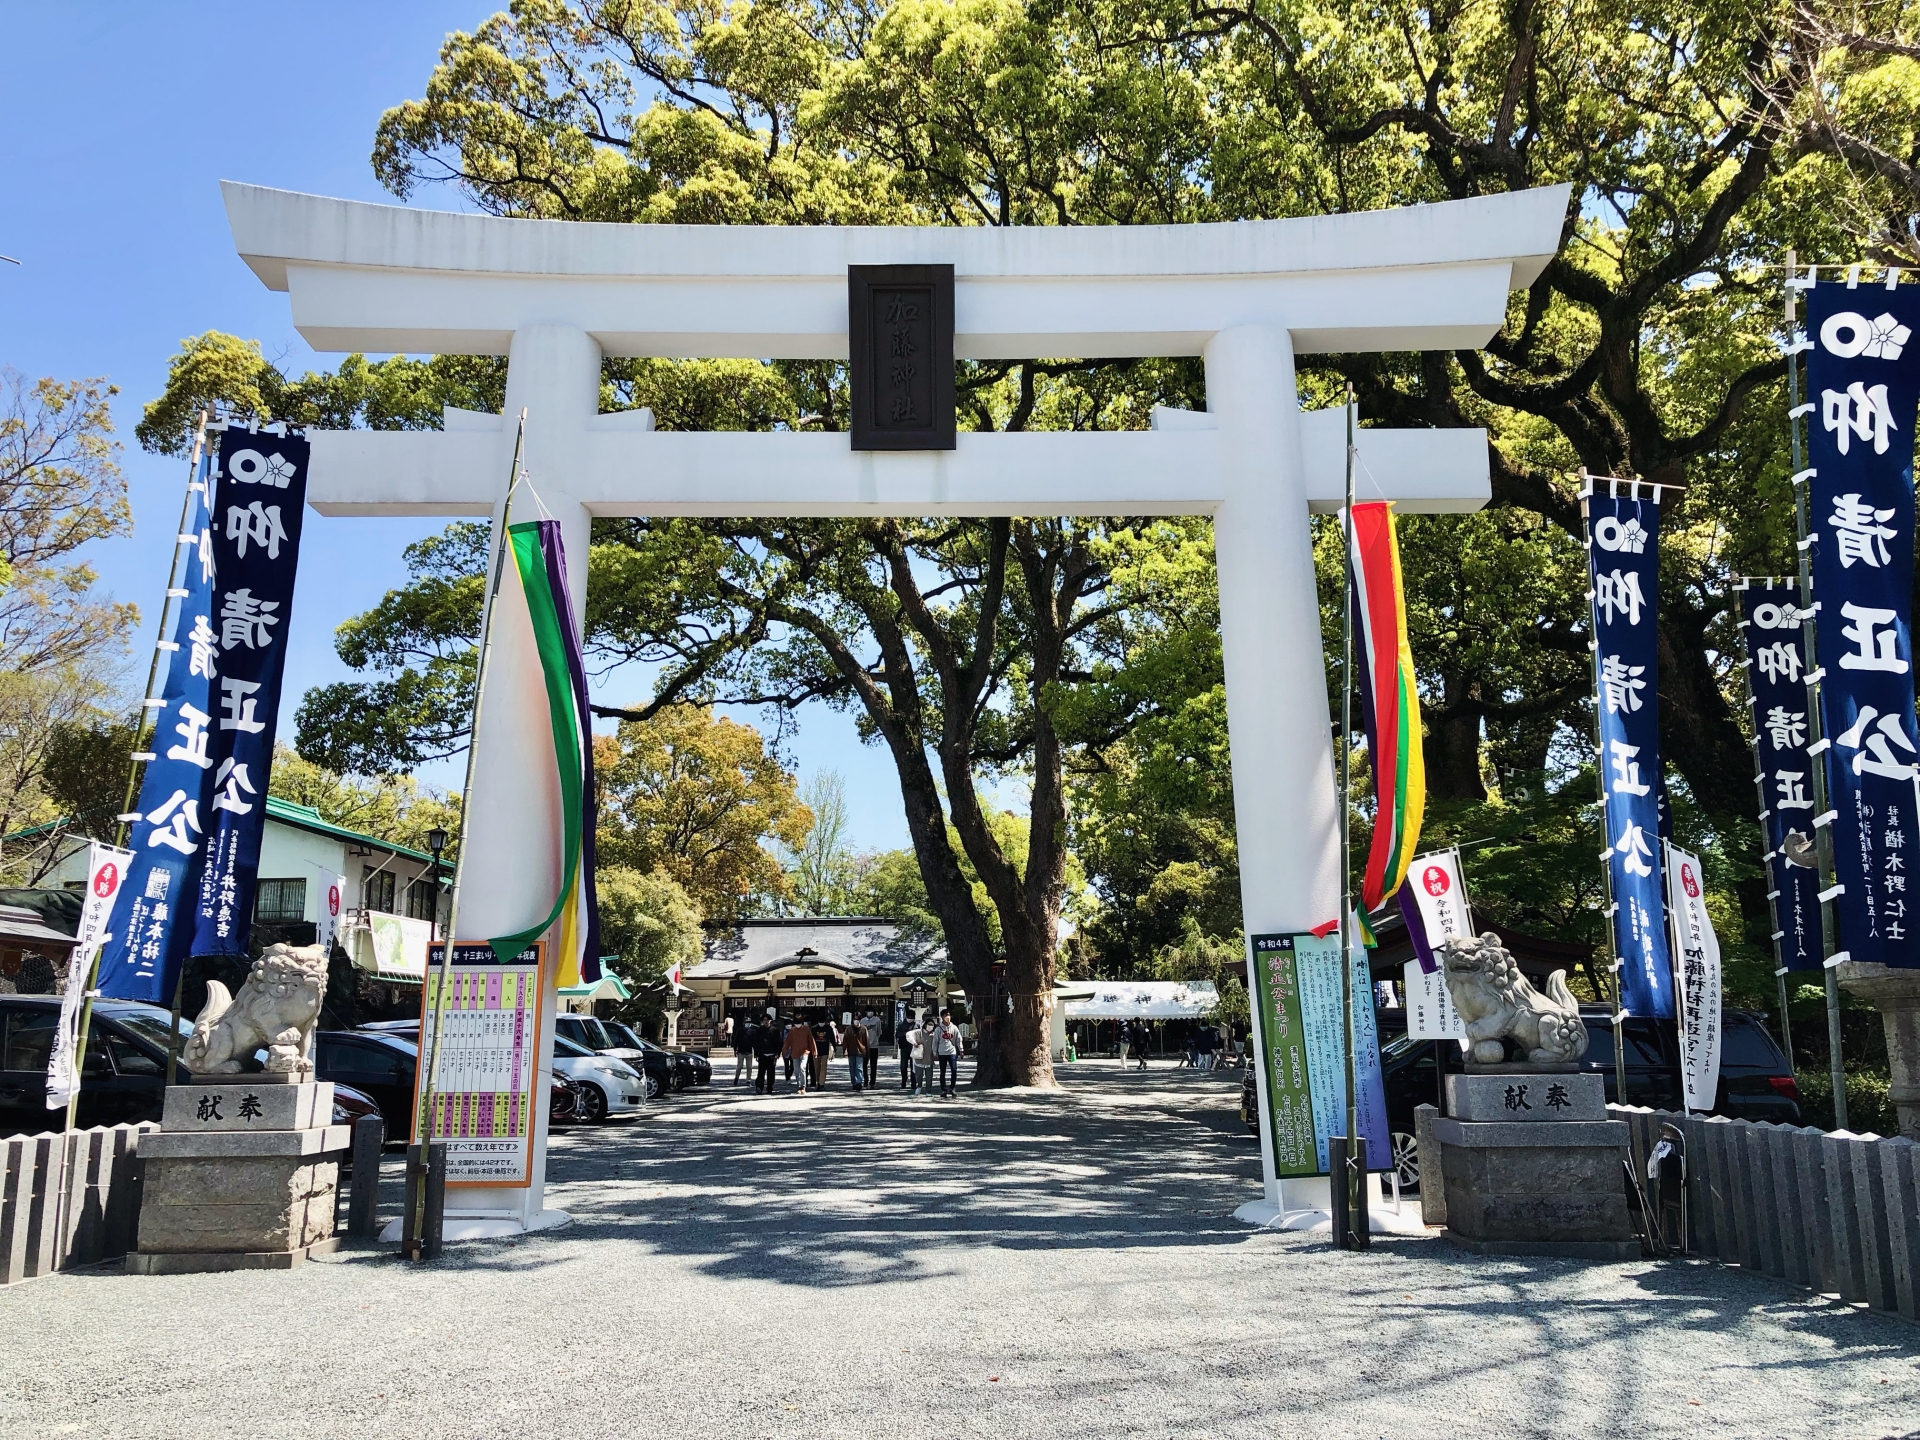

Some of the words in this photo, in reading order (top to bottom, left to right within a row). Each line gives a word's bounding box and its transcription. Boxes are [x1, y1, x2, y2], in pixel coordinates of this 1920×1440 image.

[885, 293, 919, 422] 加藤神社
[1427, 868, 1445, 894] 奉祝
[1436, 899, 1457, 935] 令和四年
[432, 951, 459, 961] 令和年
[1258, 939, 1291, 949] 令和4年
[1268, 956, 1290, 1039] 清正公まつり
